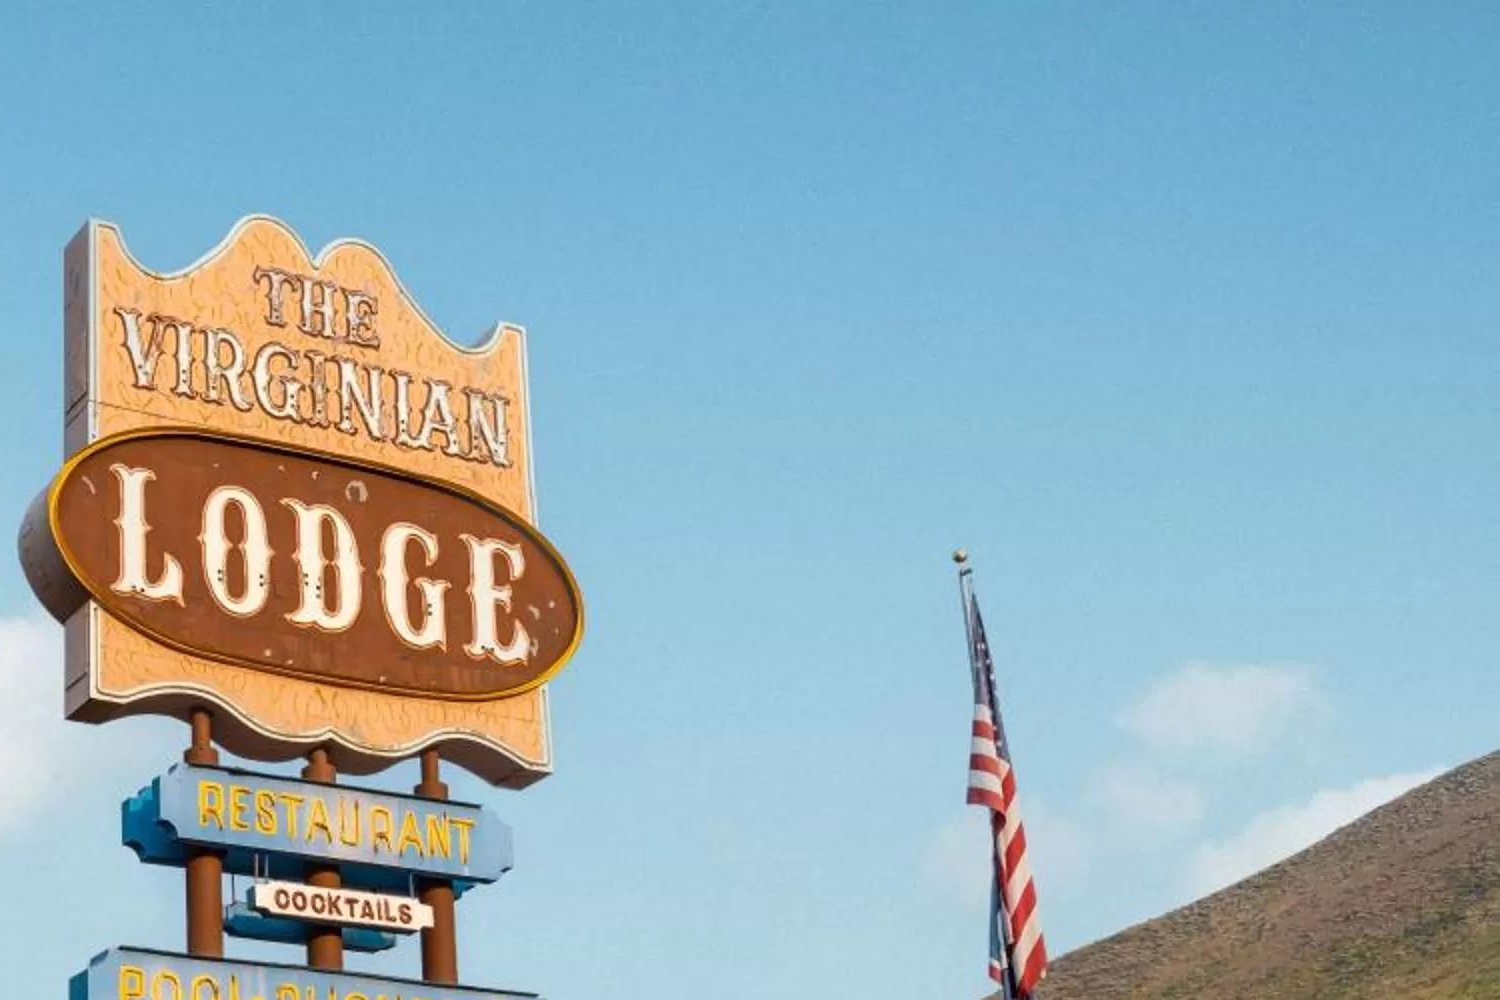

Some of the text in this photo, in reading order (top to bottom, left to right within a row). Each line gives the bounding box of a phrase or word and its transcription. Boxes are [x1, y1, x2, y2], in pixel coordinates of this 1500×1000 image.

[254, 265, 380, 349] THE
[114, 306, 512, 467] VIRGINIAN
[109, 463, 532, 665] LODGE
[197, 779, 475, 865] RESTAURANT
[274, 889, 413, 925] COCKTAILS
